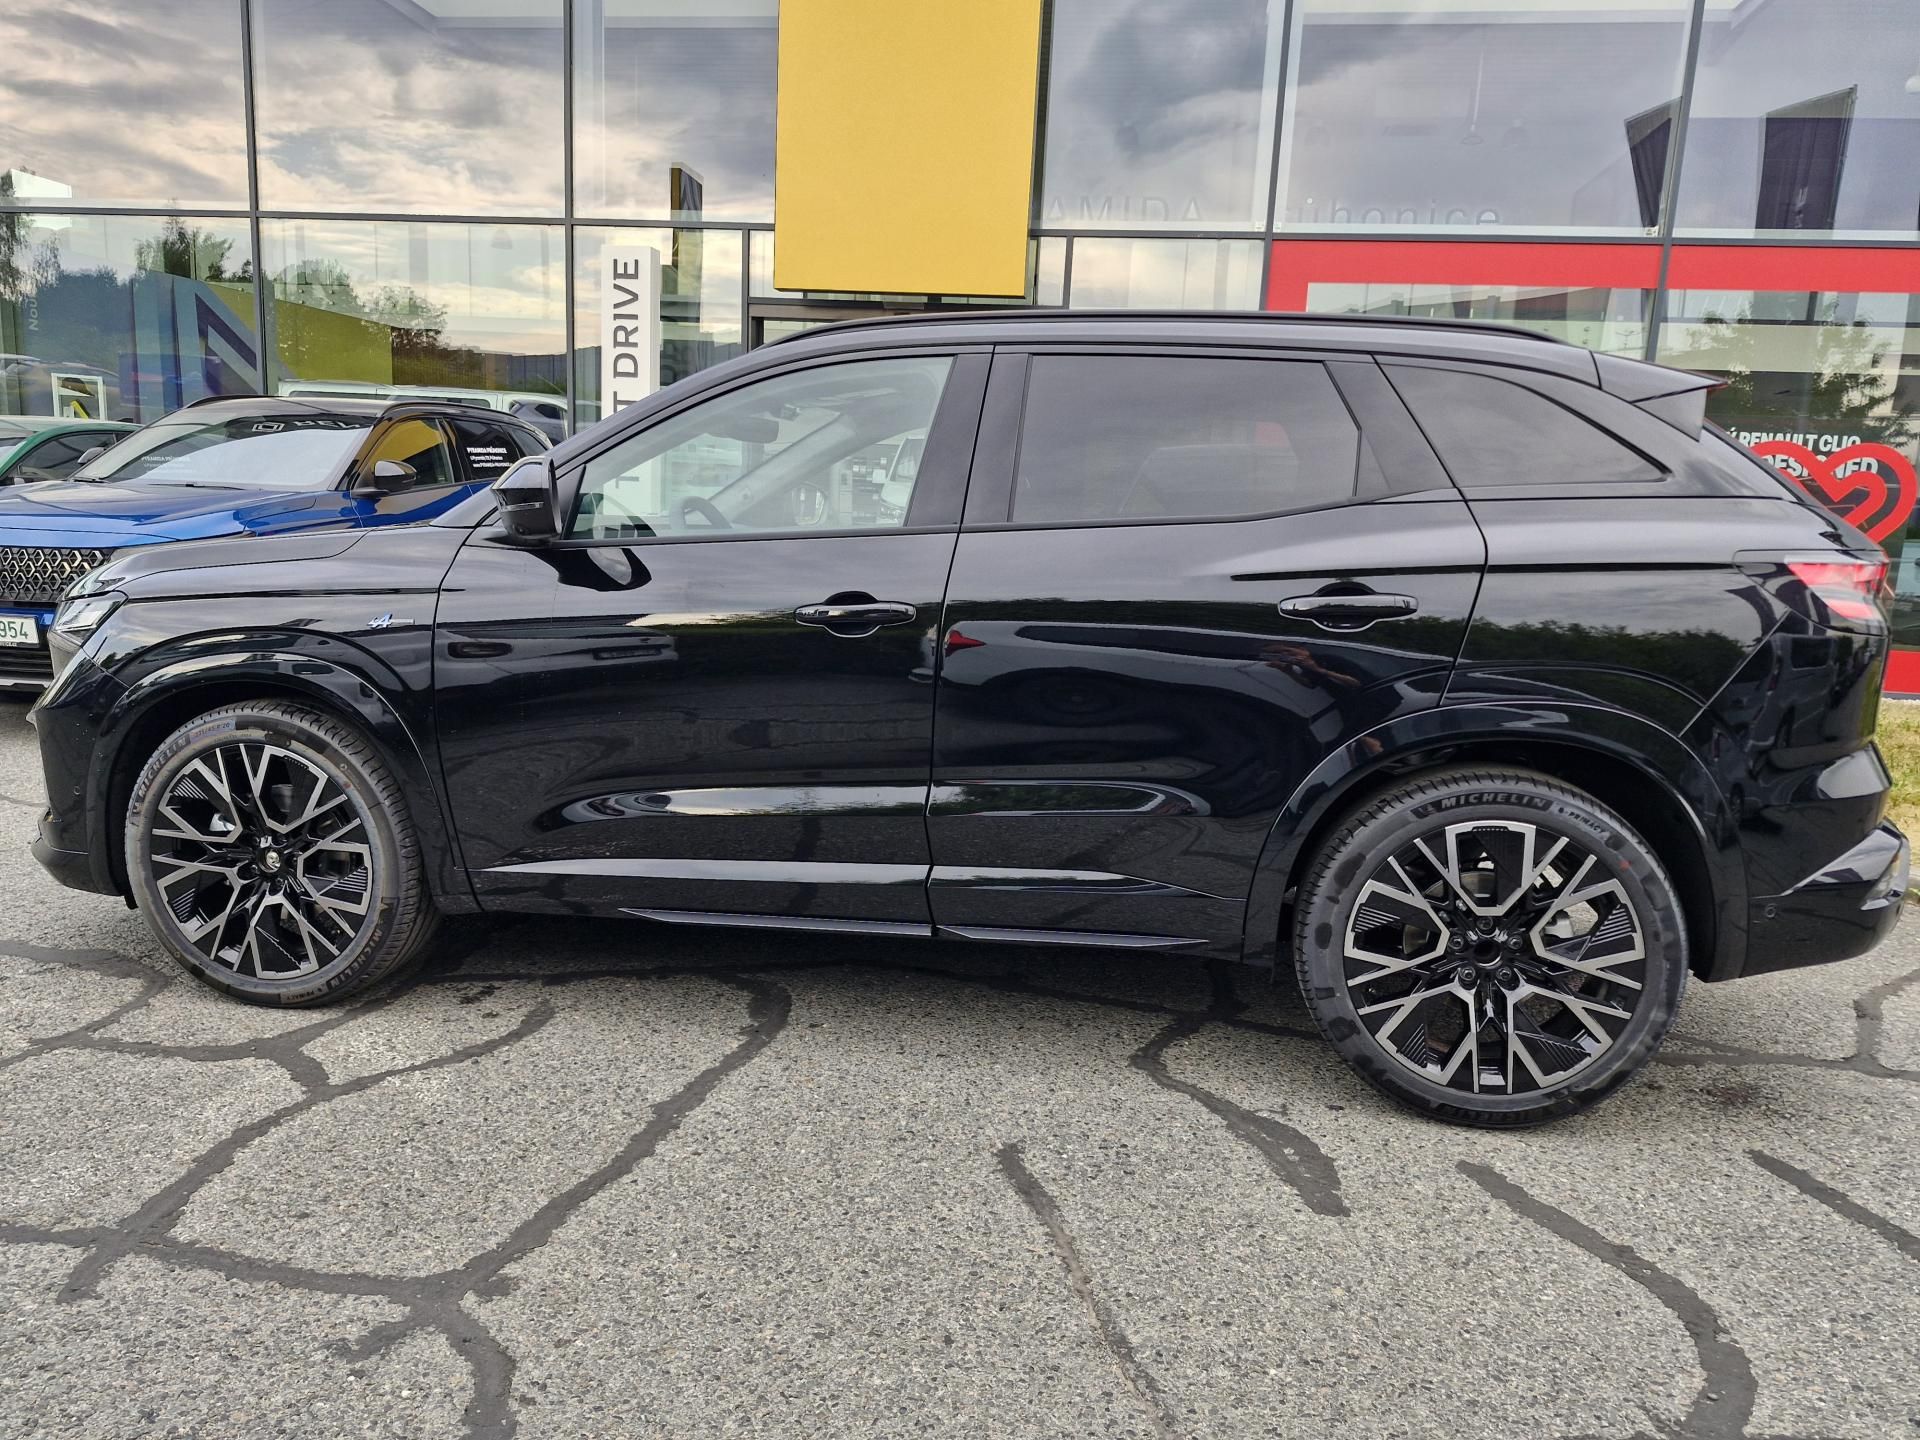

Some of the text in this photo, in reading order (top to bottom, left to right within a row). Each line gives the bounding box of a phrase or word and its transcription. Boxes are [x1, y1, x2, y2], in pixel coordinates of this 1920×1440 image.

[613, 258, 639, 379] DRIVE
[1818, 434, 1862, 453] CLIO
[138, 737, 187, 798] MICHELIN
[1441, 793, 1546, 809] MICHELIN
